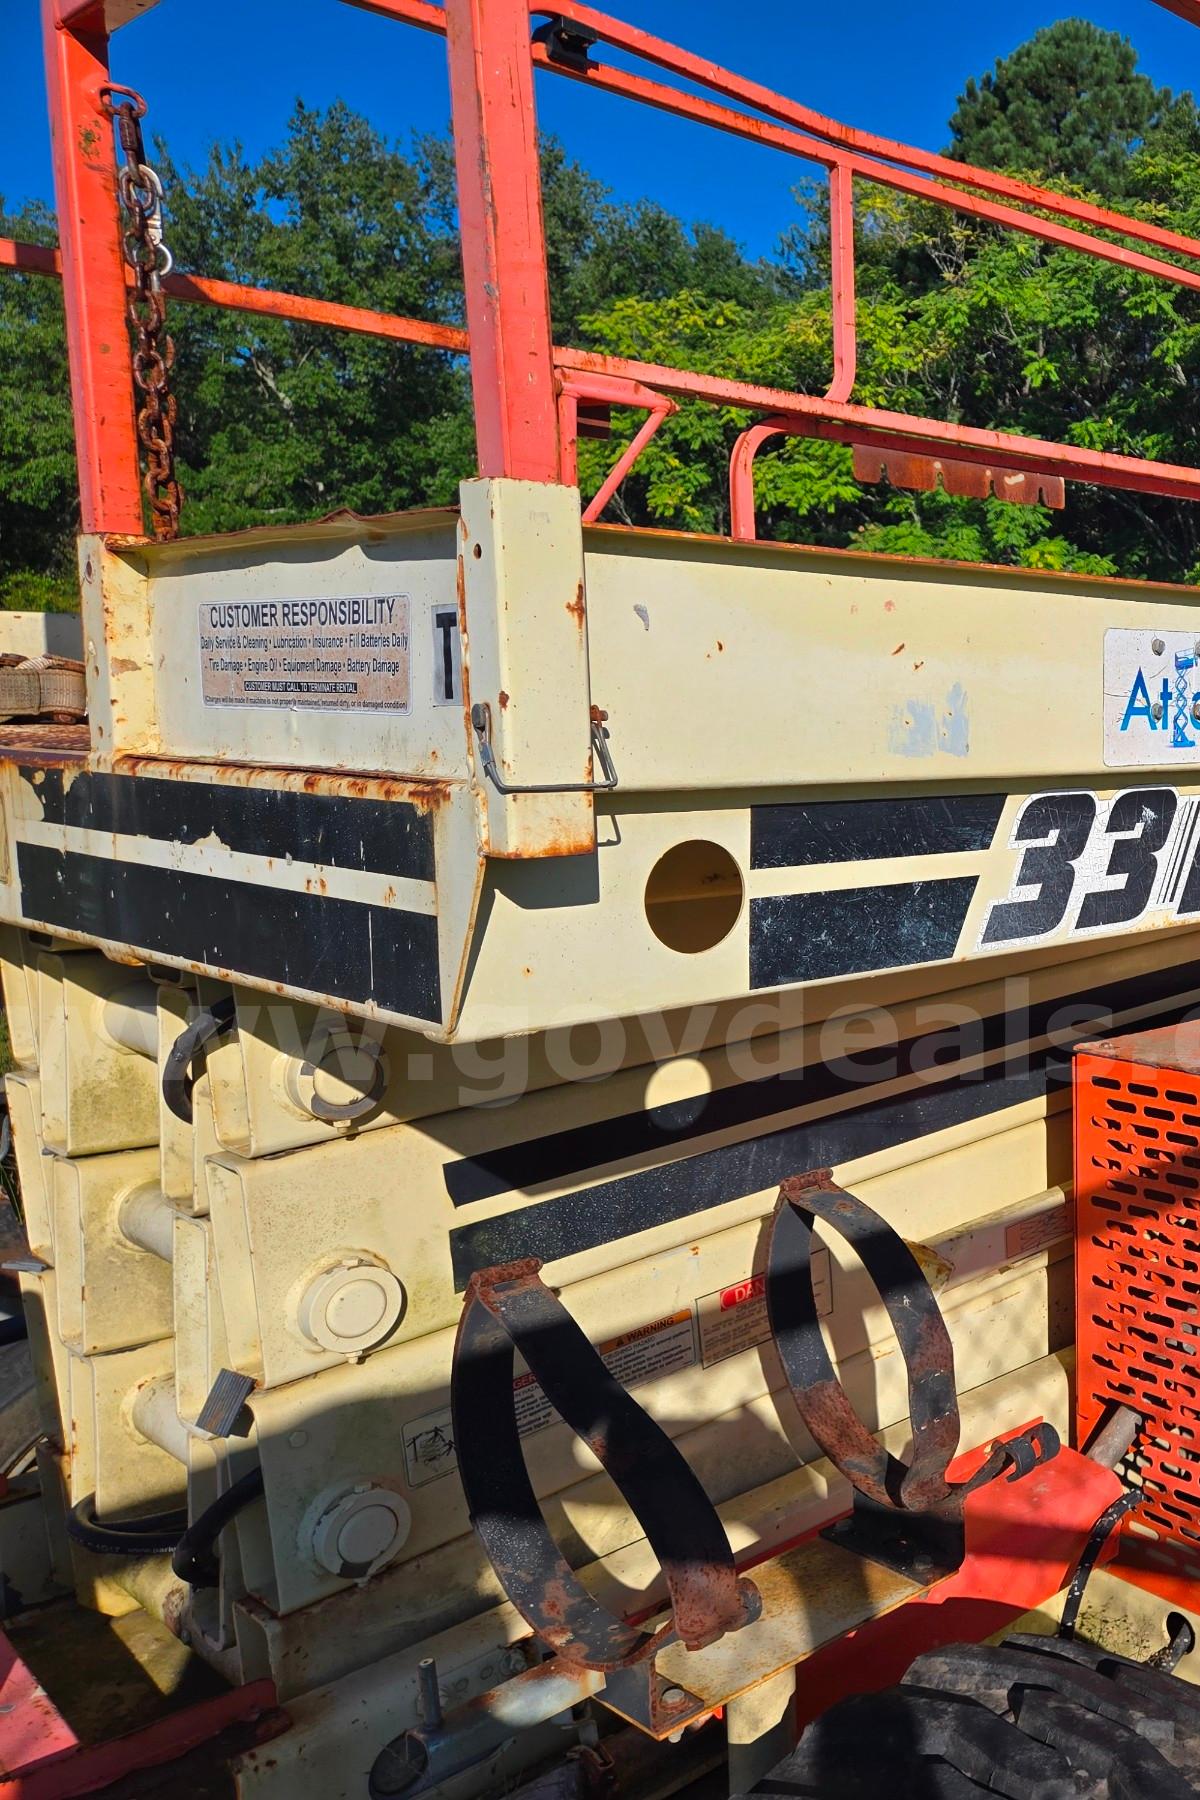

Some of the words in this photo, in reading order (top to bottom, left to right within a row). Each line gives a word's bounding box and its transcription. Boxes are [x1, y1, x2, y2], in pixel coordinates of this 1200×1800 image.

[210, 603, 278, 628] CUSTOMER
[282, 599, 396, 627] RESPONSIBILITY
[201, 636, 214, 652] Daily
[215, 636, 236, 649] Service
[242, 635, 268, 652] Cleaning
[273, 635, 308, 649] Lubrication
[312, 634, 344, 648] Insurance
[349, 632, 360, 648] Fill
[361, 632, 390, 648] Batteries
[391, 632, 408, 651] Daily
[209, 658, 220, 671] Tire
[220, 658, 243, 674] Damage
[247, 658, 268, 675] Engine
[269, 658, 278, 671] Oil
[282, 658, 315, 675] Equipment
[316, 658, 342, 675] Damage
[347, 658, 371, 676] Battery
[372, 658, 400, 676] Damage
[245, 681, 272, 691] CUSTOMER
[272, 681, 286, 691] MUST
[286, 682, 301, 692] CALL
[308, 682, 336, 692] TERMINATE
[336, 682, 357, 693] RENTAL
[627, 1316, 675, 1343] WARNING
